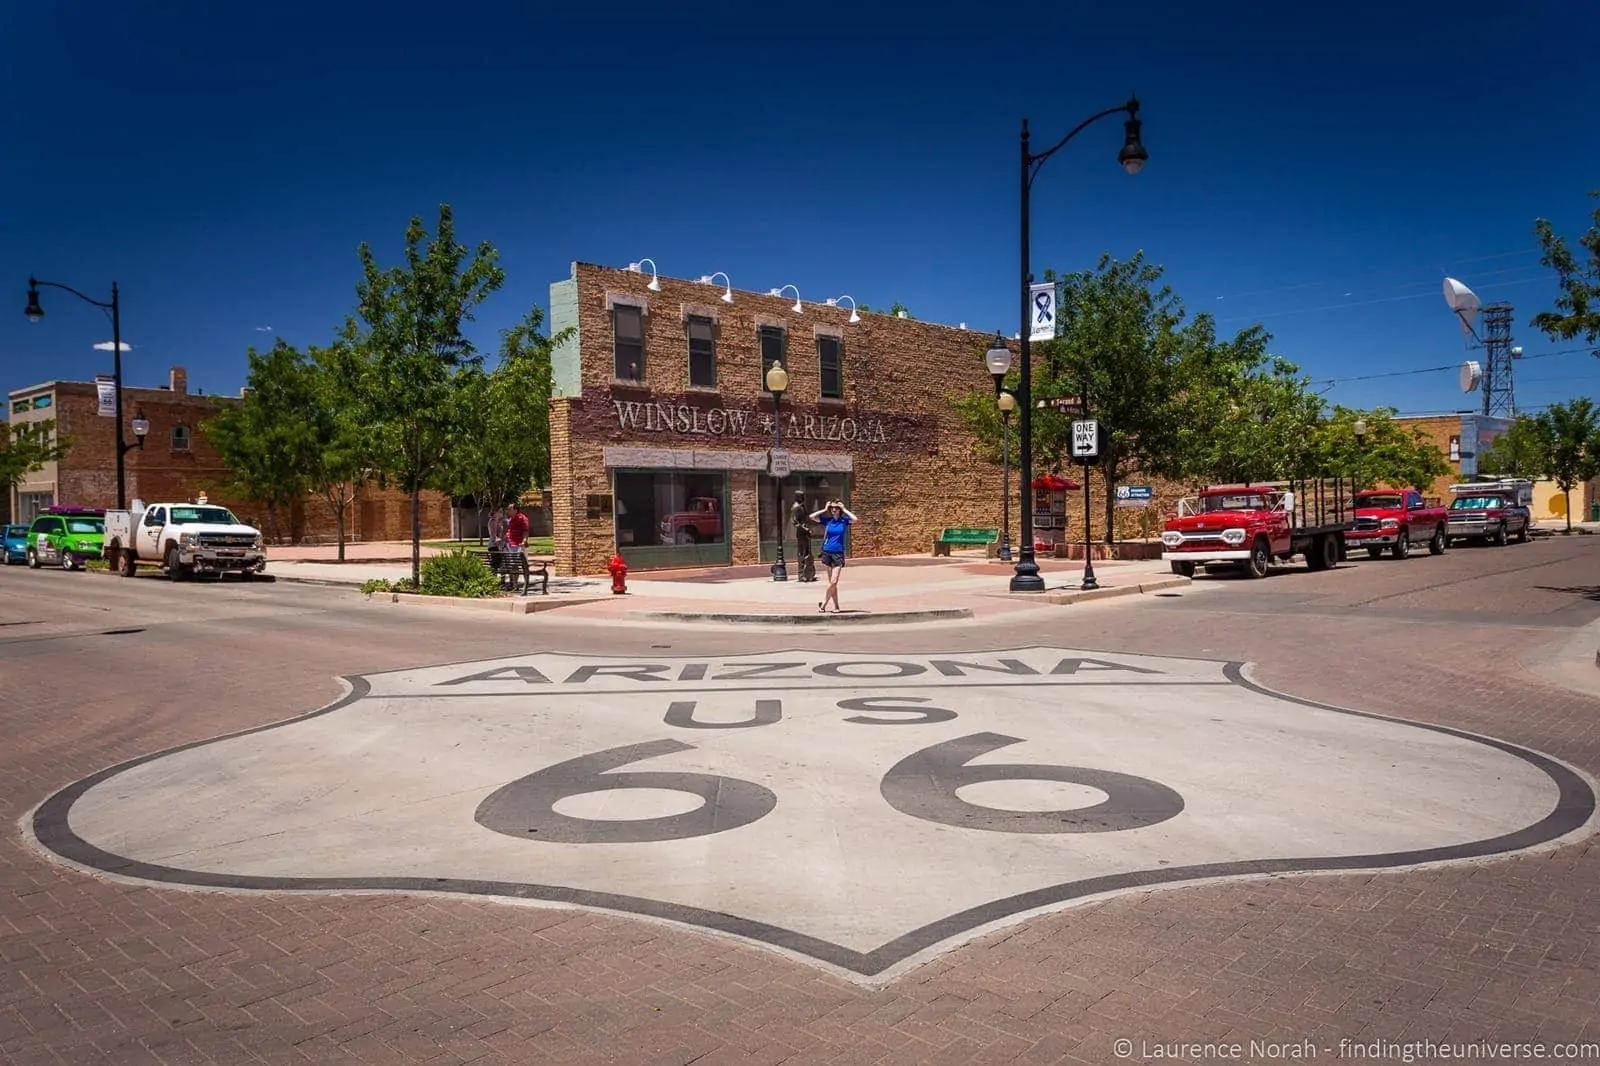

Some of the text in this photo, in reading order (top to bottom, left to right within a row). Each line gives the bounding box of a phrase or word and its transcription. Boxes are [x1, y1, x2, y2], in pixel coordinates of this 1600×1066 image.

[613, 400, 887, 443] WINSLOW ARIZONA
[1075, 433, 1094, 441] WAY
[1076, 423, 1094, 433] ONE
[432, 657, 1168, 687] ARIZONA
[664, 697, 958, 730] US
[474, 732, 1184, 844] 66
